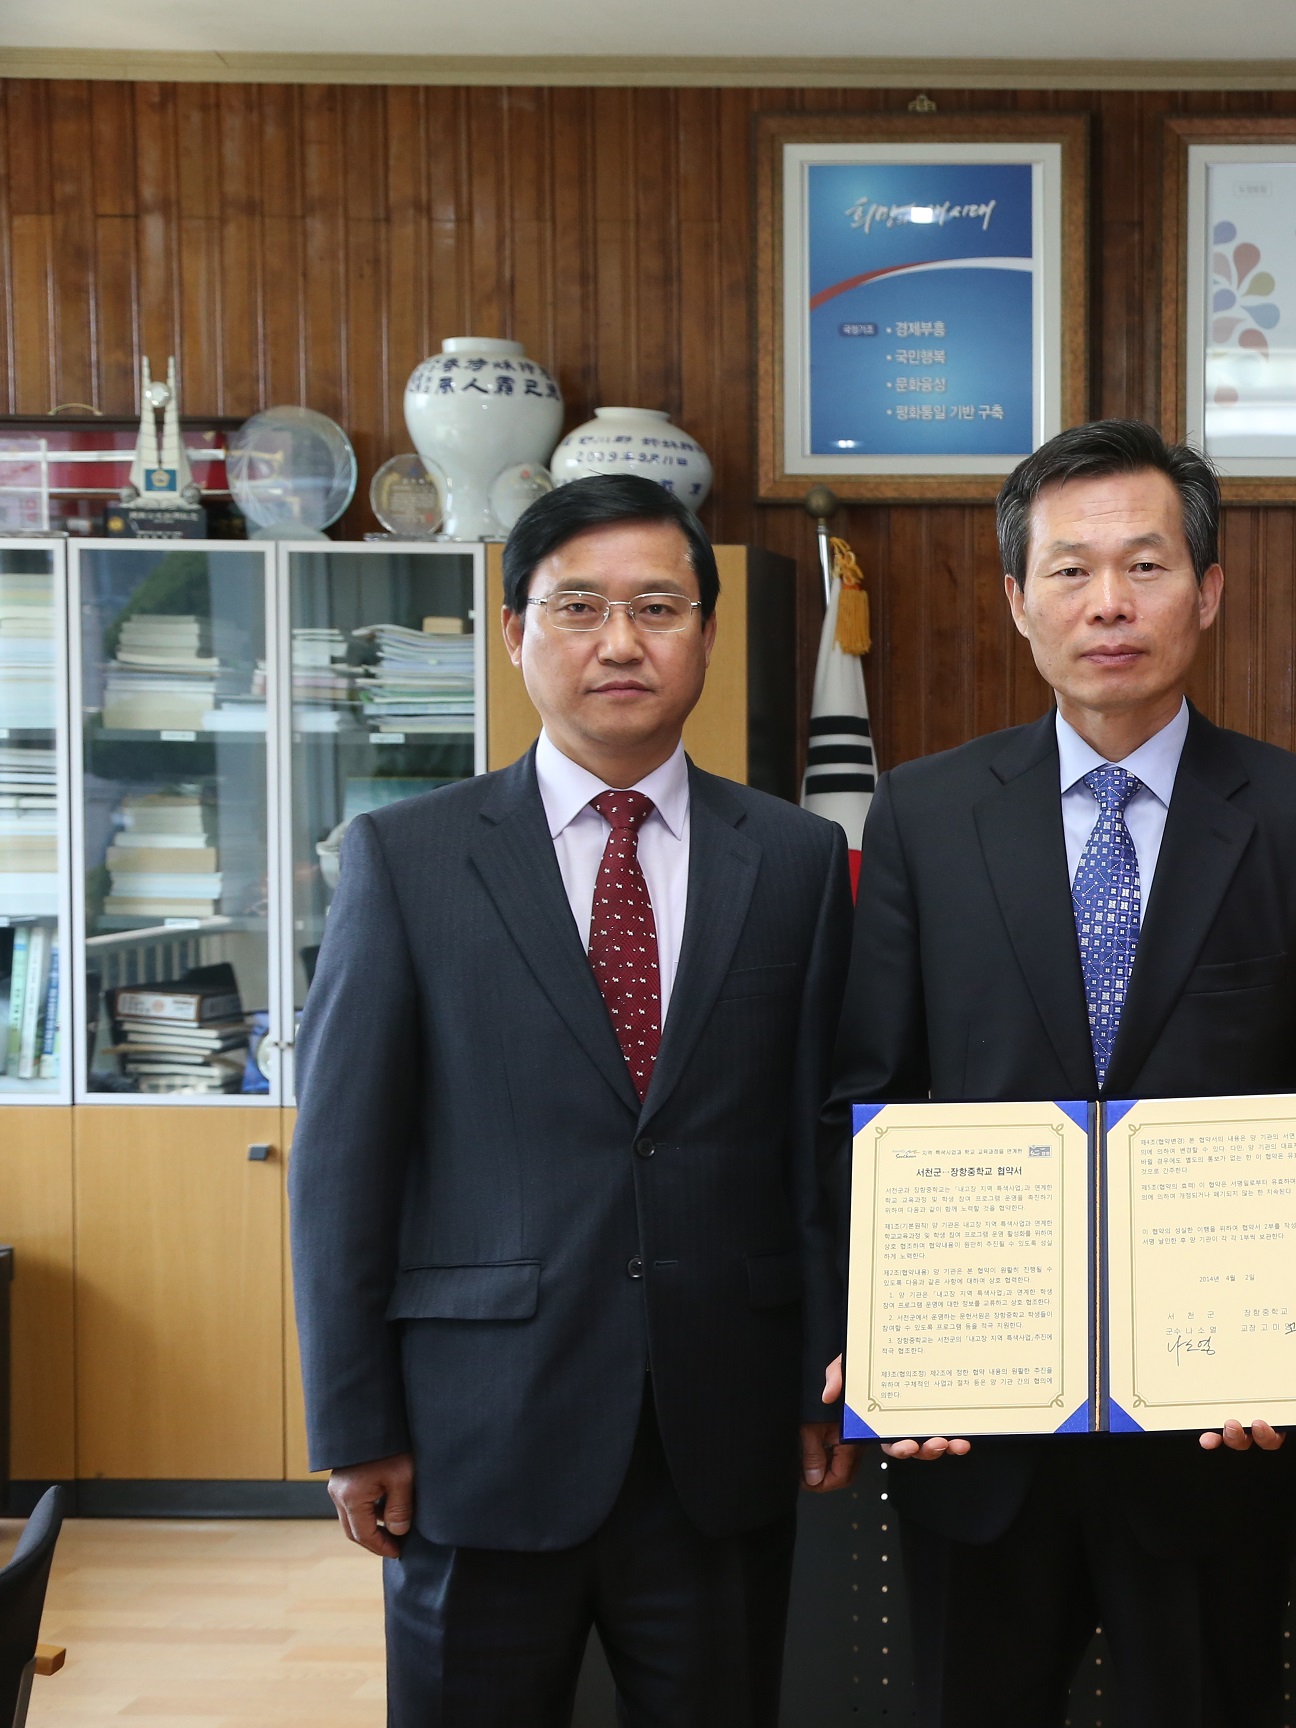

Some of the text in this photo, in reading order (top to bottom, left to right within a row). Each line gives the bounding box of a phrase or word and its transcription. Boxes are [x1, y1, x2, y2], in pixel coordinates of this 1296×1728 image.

[896, 321, 946, 337] 경제부흥
[896, 349, 946, 364] 국민행복
[896, 377, 946, 392] 문화융성
[896, 404, 1004, 420] 평화통일 기반 구축
[917, 1166, 1021, 1177] 서천군 장항중학교 협약서
